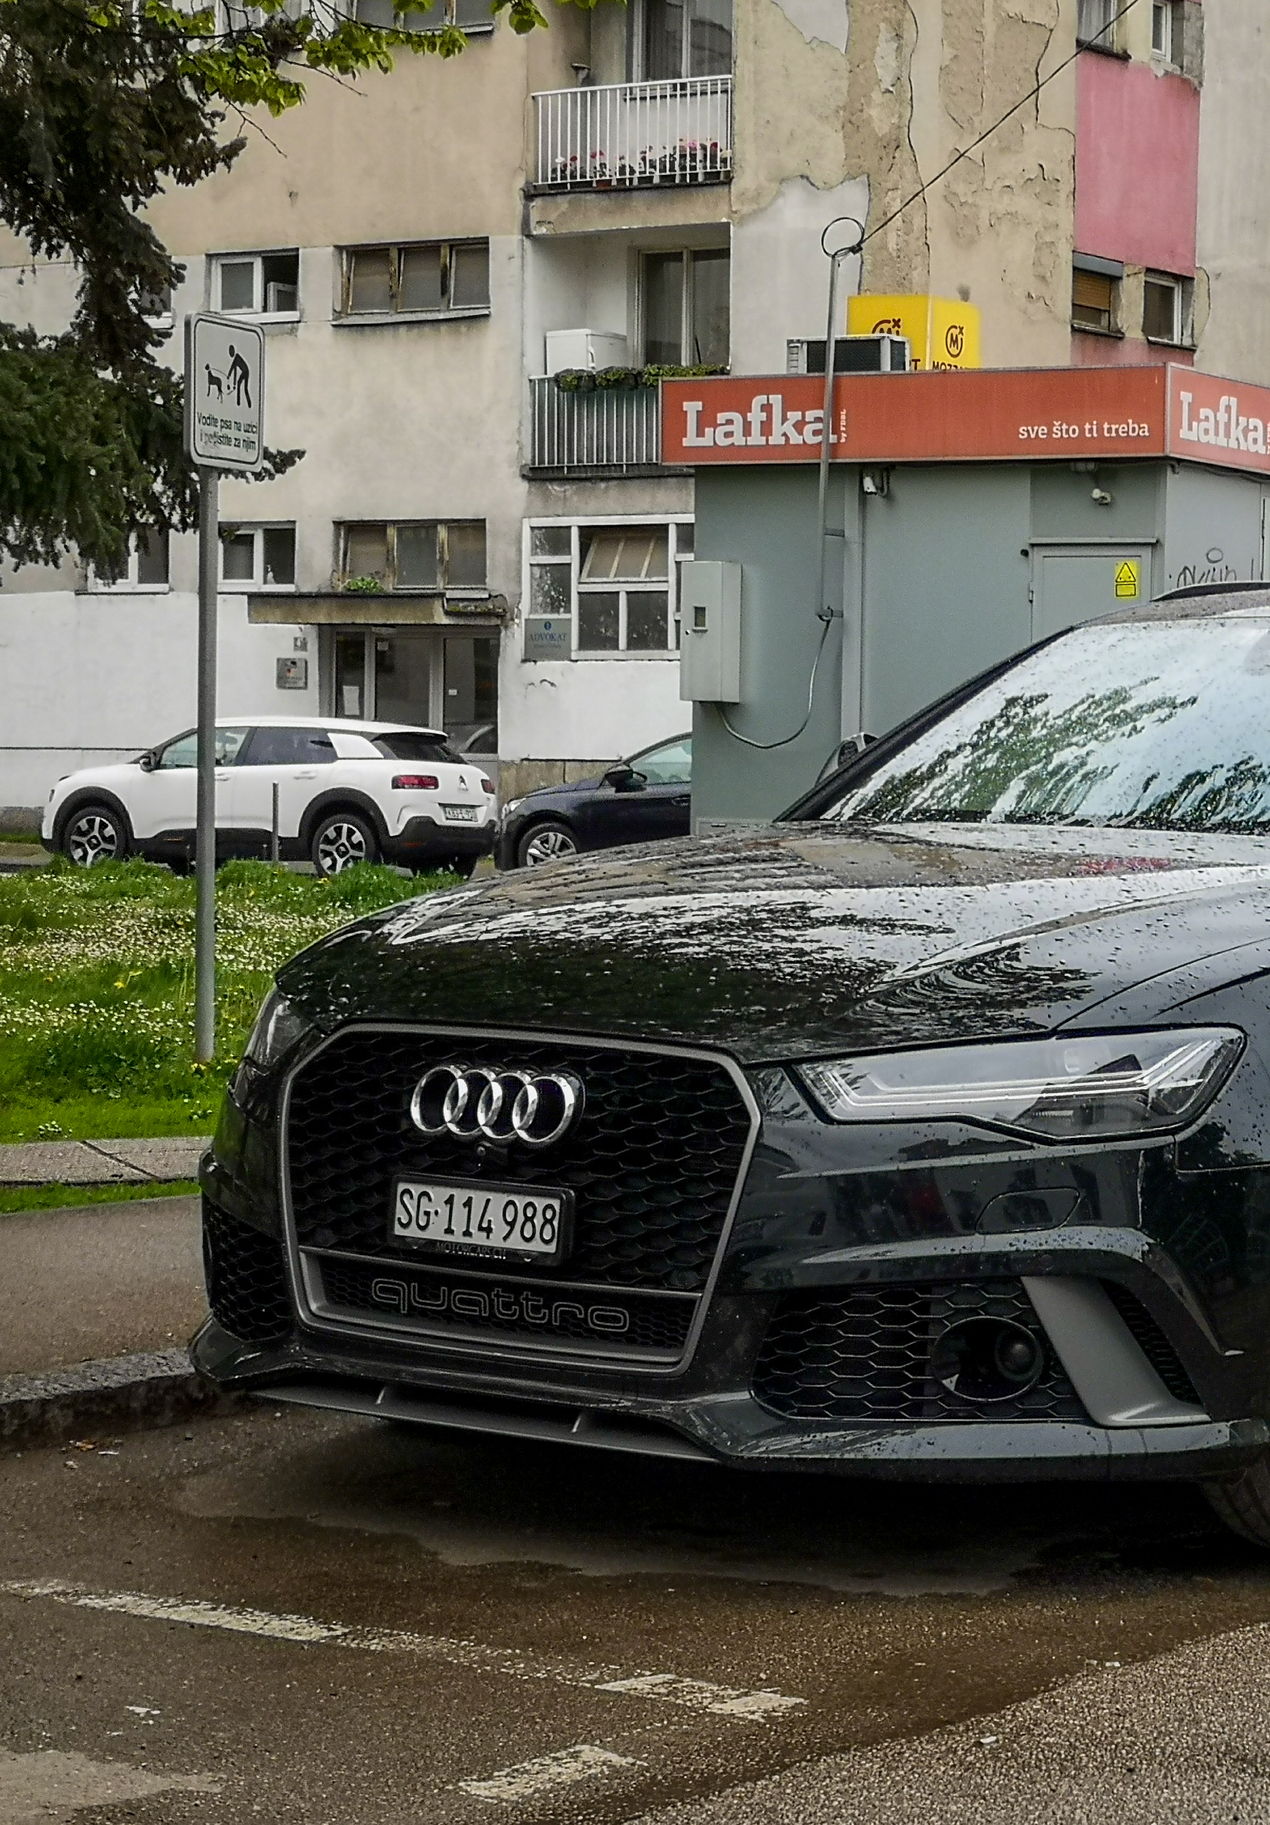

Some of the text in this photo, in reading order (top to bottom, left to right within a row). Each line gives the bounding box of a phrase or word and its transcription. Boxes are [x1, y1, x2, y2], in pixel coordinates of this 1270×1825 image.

[197, 412, 219, 428] Vodite
[220, 418, 232, 432] psa
[233, 421, 242, 431] na
[682, 394, 838, 447] Lafka
[1018, 419, 1149, 439] sve što ti treba
[1179, 390, 1266, 455] Lafka
[234, 437, 241, 448] za
[372, 1277, 629, 1333] quattro
